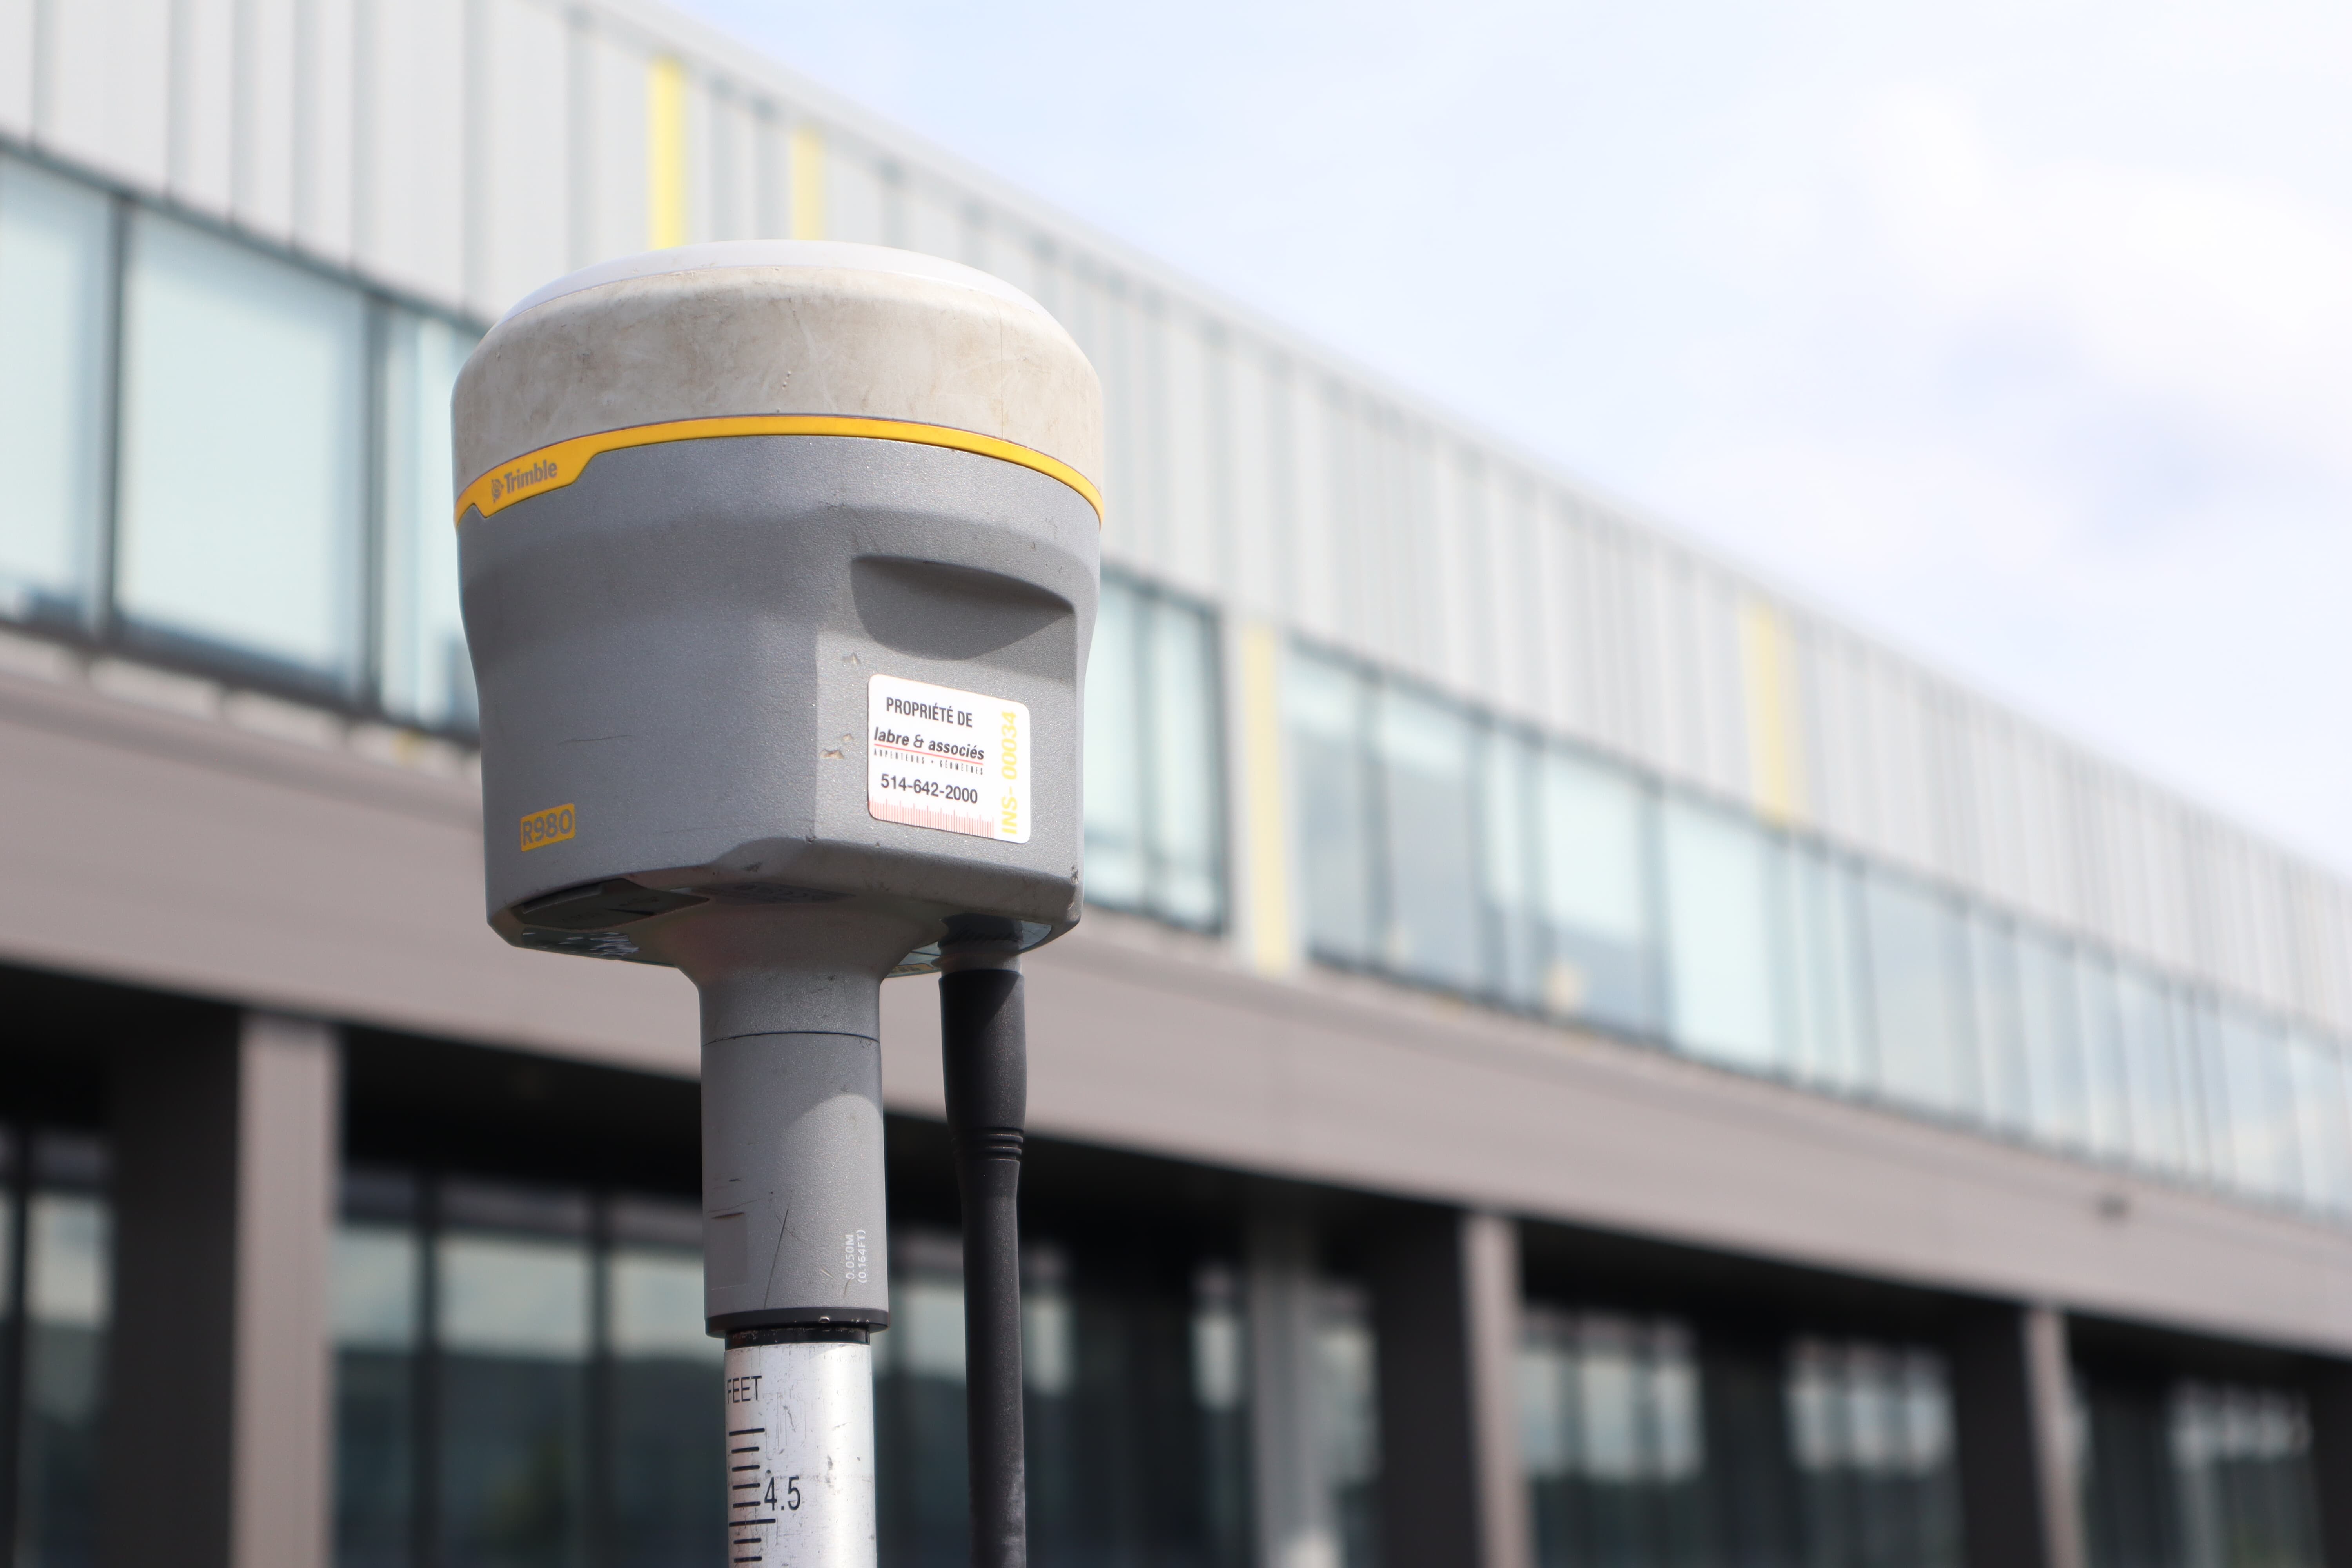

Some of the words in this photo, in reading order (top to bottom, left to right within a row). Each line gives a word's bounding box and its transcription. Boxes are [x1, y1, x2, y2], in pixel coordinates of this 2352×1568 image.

[504, 460, 557, 494] Trimble
[886, 697, 953, 724] PROPRIÉTÉ
[957, 711, 973, 728] DE
[874, 726, 909, 746] labre
[913, 734, 924, 748] &
[928, 739, 985, 760] associés
[1001, 710, 1018, 780] 00034
[880, 773, 978, 804] 514-642-2000
[522, 809, 573, 846] R980
[1001, 786, 1018, 835] INS-
[845, 1234, 855, 1280] 0.050M
[856, 1229, 867, 1283] (0.164FT)
[727, 1375, 762, 1405] FEET
[764, 1476, 801, 1512] 4.5
